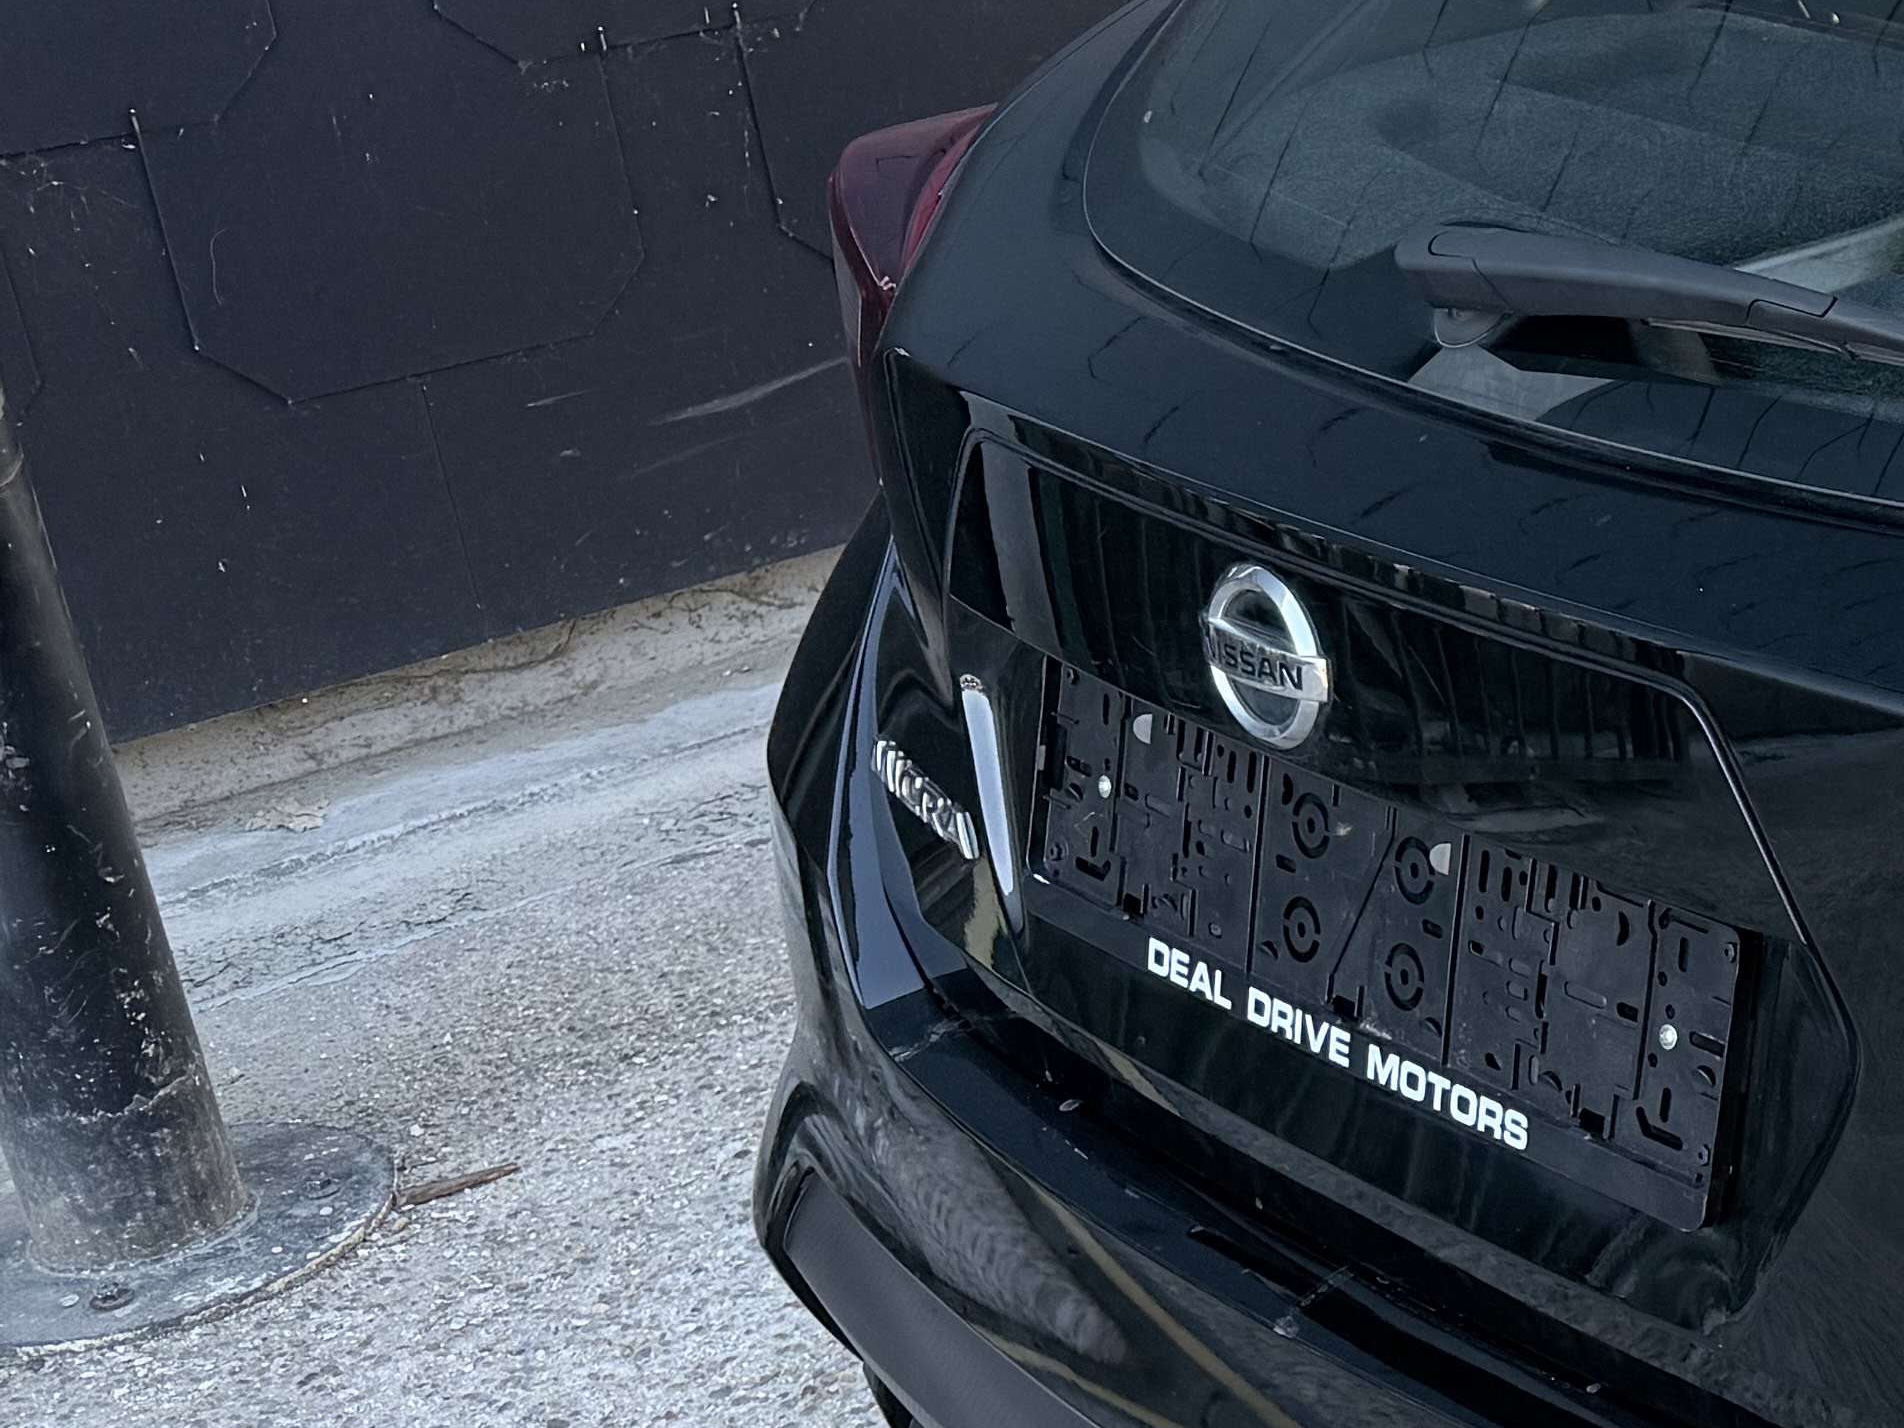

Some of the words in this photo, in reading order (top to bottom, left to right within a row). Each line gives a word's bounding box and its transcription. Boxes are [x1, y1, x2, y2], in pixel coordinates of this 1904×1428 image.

[1205, 626, 1304, 692] NISSAN
[1147, 937, 1232, 1011] DEAL
[1246, 985, 1351, 1069] DRIVE
[1366, 1043, 1529, 1151] MOTORS
